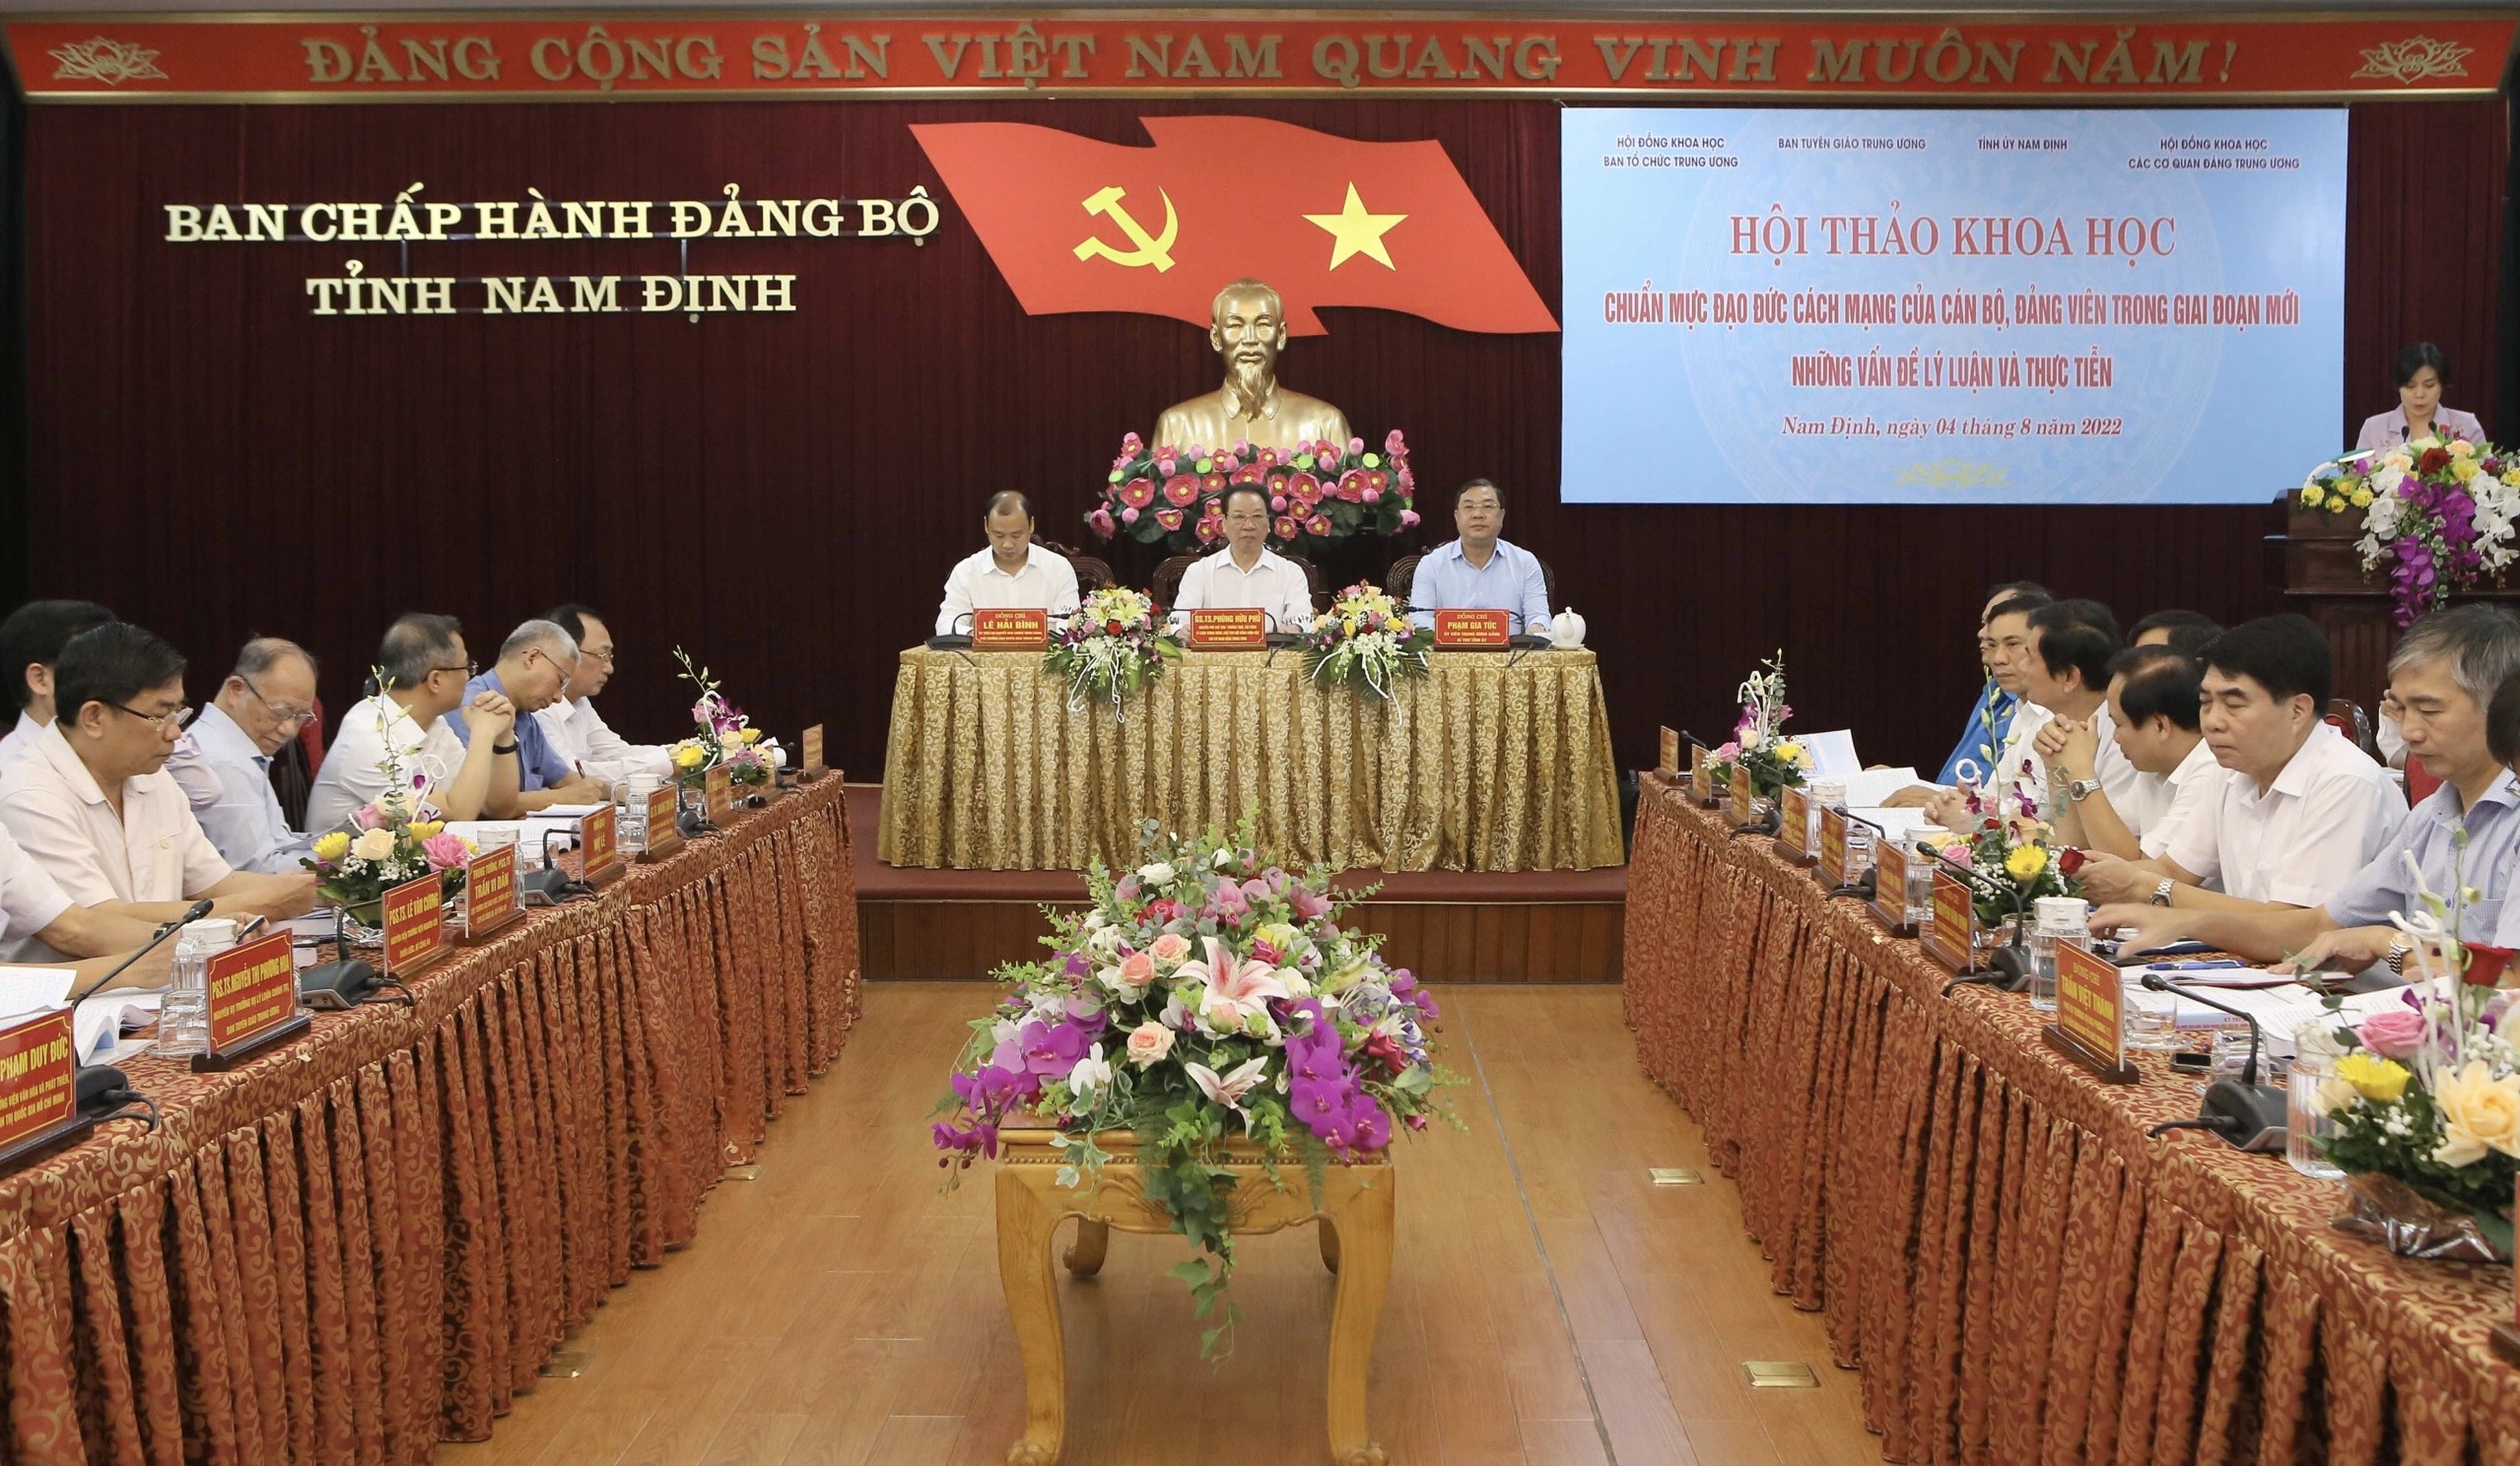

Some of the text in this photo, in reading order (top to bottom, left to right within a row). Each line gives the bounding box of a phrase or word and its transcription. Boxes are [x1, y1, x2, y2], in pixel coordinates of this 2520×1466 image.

[303, 23, 2237, 91] ĐẢNG CỘNG SẢN VIỆT NAM QUANG VINH MUÔN NĂM!
[165, 182, 938, 246] BAN CHẤP HÀNH ĐẢNG BỘ
[1731, 200, 2176, 268] HỘI THẢO KHOA HỌC
[306, 260, 796, 322] TỈNH NAM ĐỊNH
[1605, 281, 2298, 332] CHUẨN MỰC ĐẠO ĐỨC CÁCH MẠNG CỦA CÁN BỘ, ĐẢNG VIÊN TRONG GIAI ĐOẠN MỚI
[1793, 346, 2112, 394] NHỮNG VẤN ĐỀ LÝ LUẬN VÀ THỰC TIỄN
[1783, 417, 2123, 439] Nam Định, ngày 04 tháng 8 năm 2022
[983, 619, 1039, 629] LÊ HẢI BÌNH
[1448, 622, 1468, 631] PHẠM
[0, 1033, 68, 1082] PHẠM DUY ĐỨC
